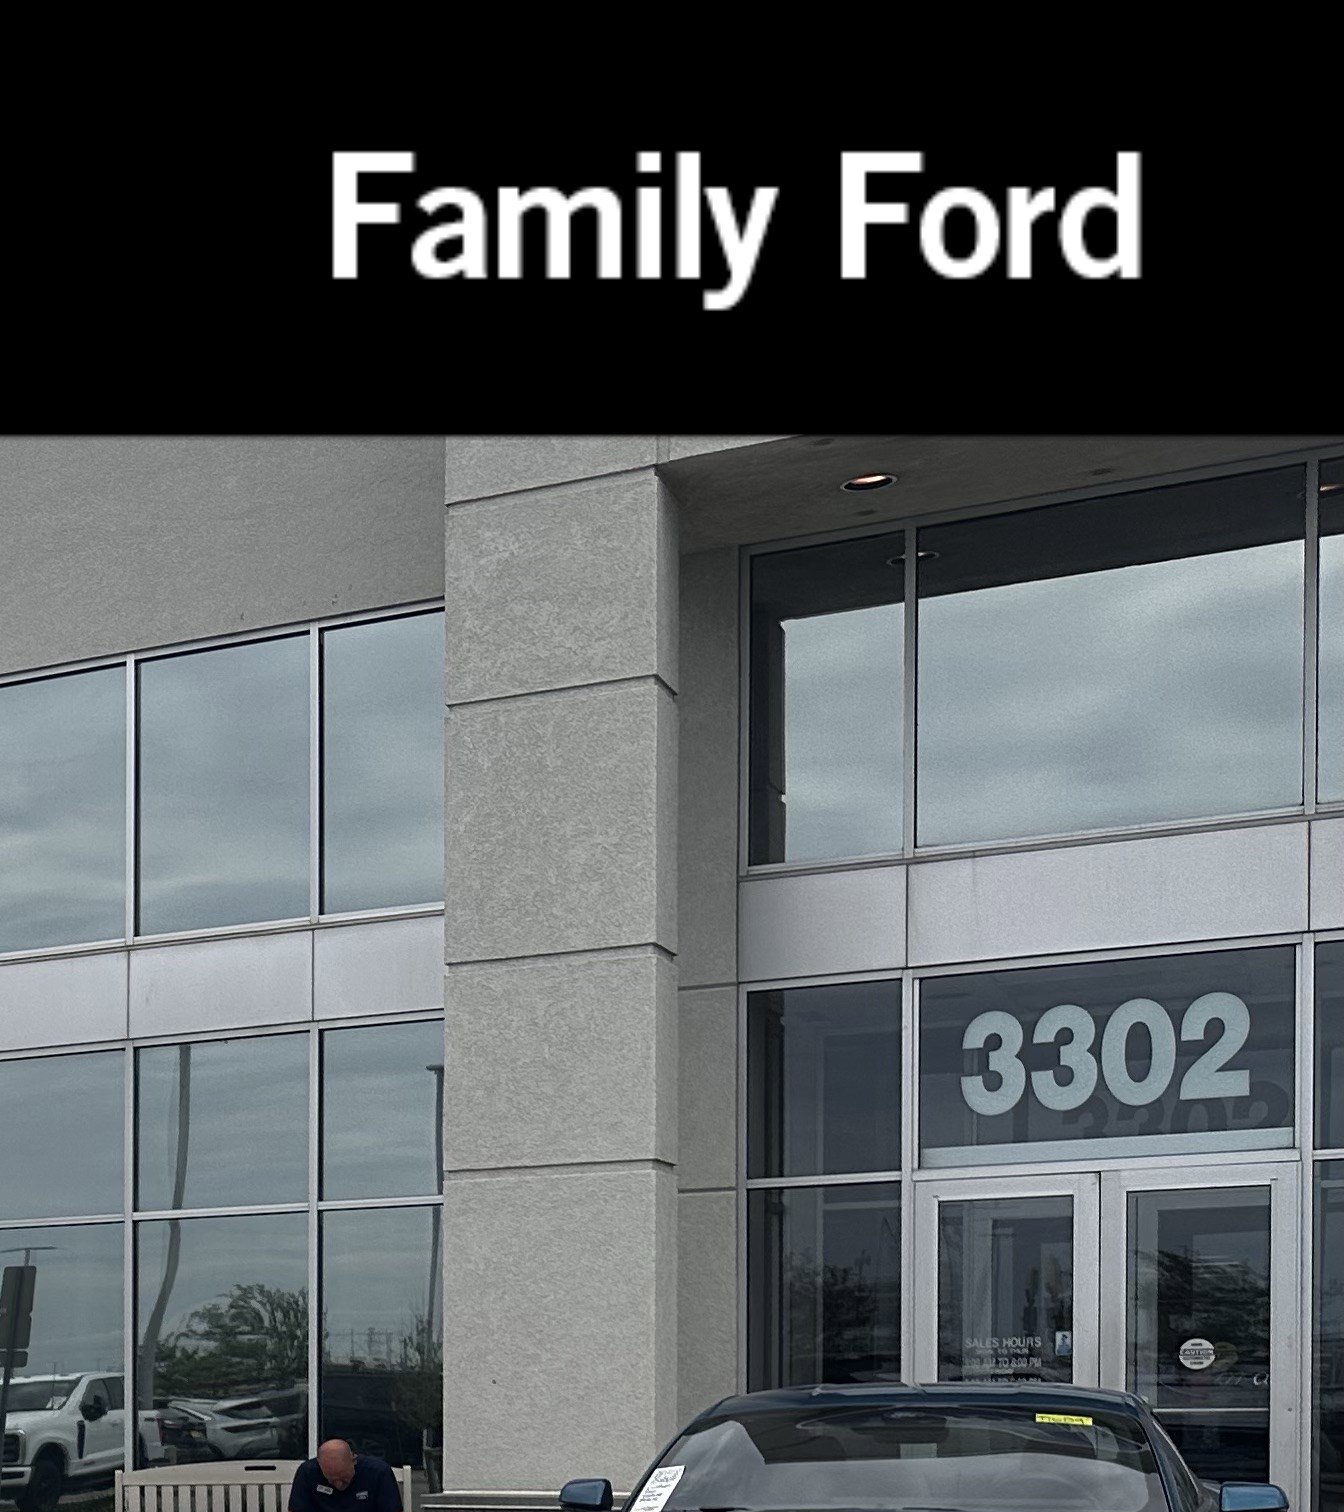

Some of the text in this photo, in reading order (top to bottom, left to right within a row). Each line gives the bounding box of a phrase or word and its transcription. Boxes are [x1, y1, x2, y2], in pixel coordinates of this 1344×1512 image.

[961, 992, 1250, 1116] 3302
[964, 1336, 1042, 1349] SALES HOURS
